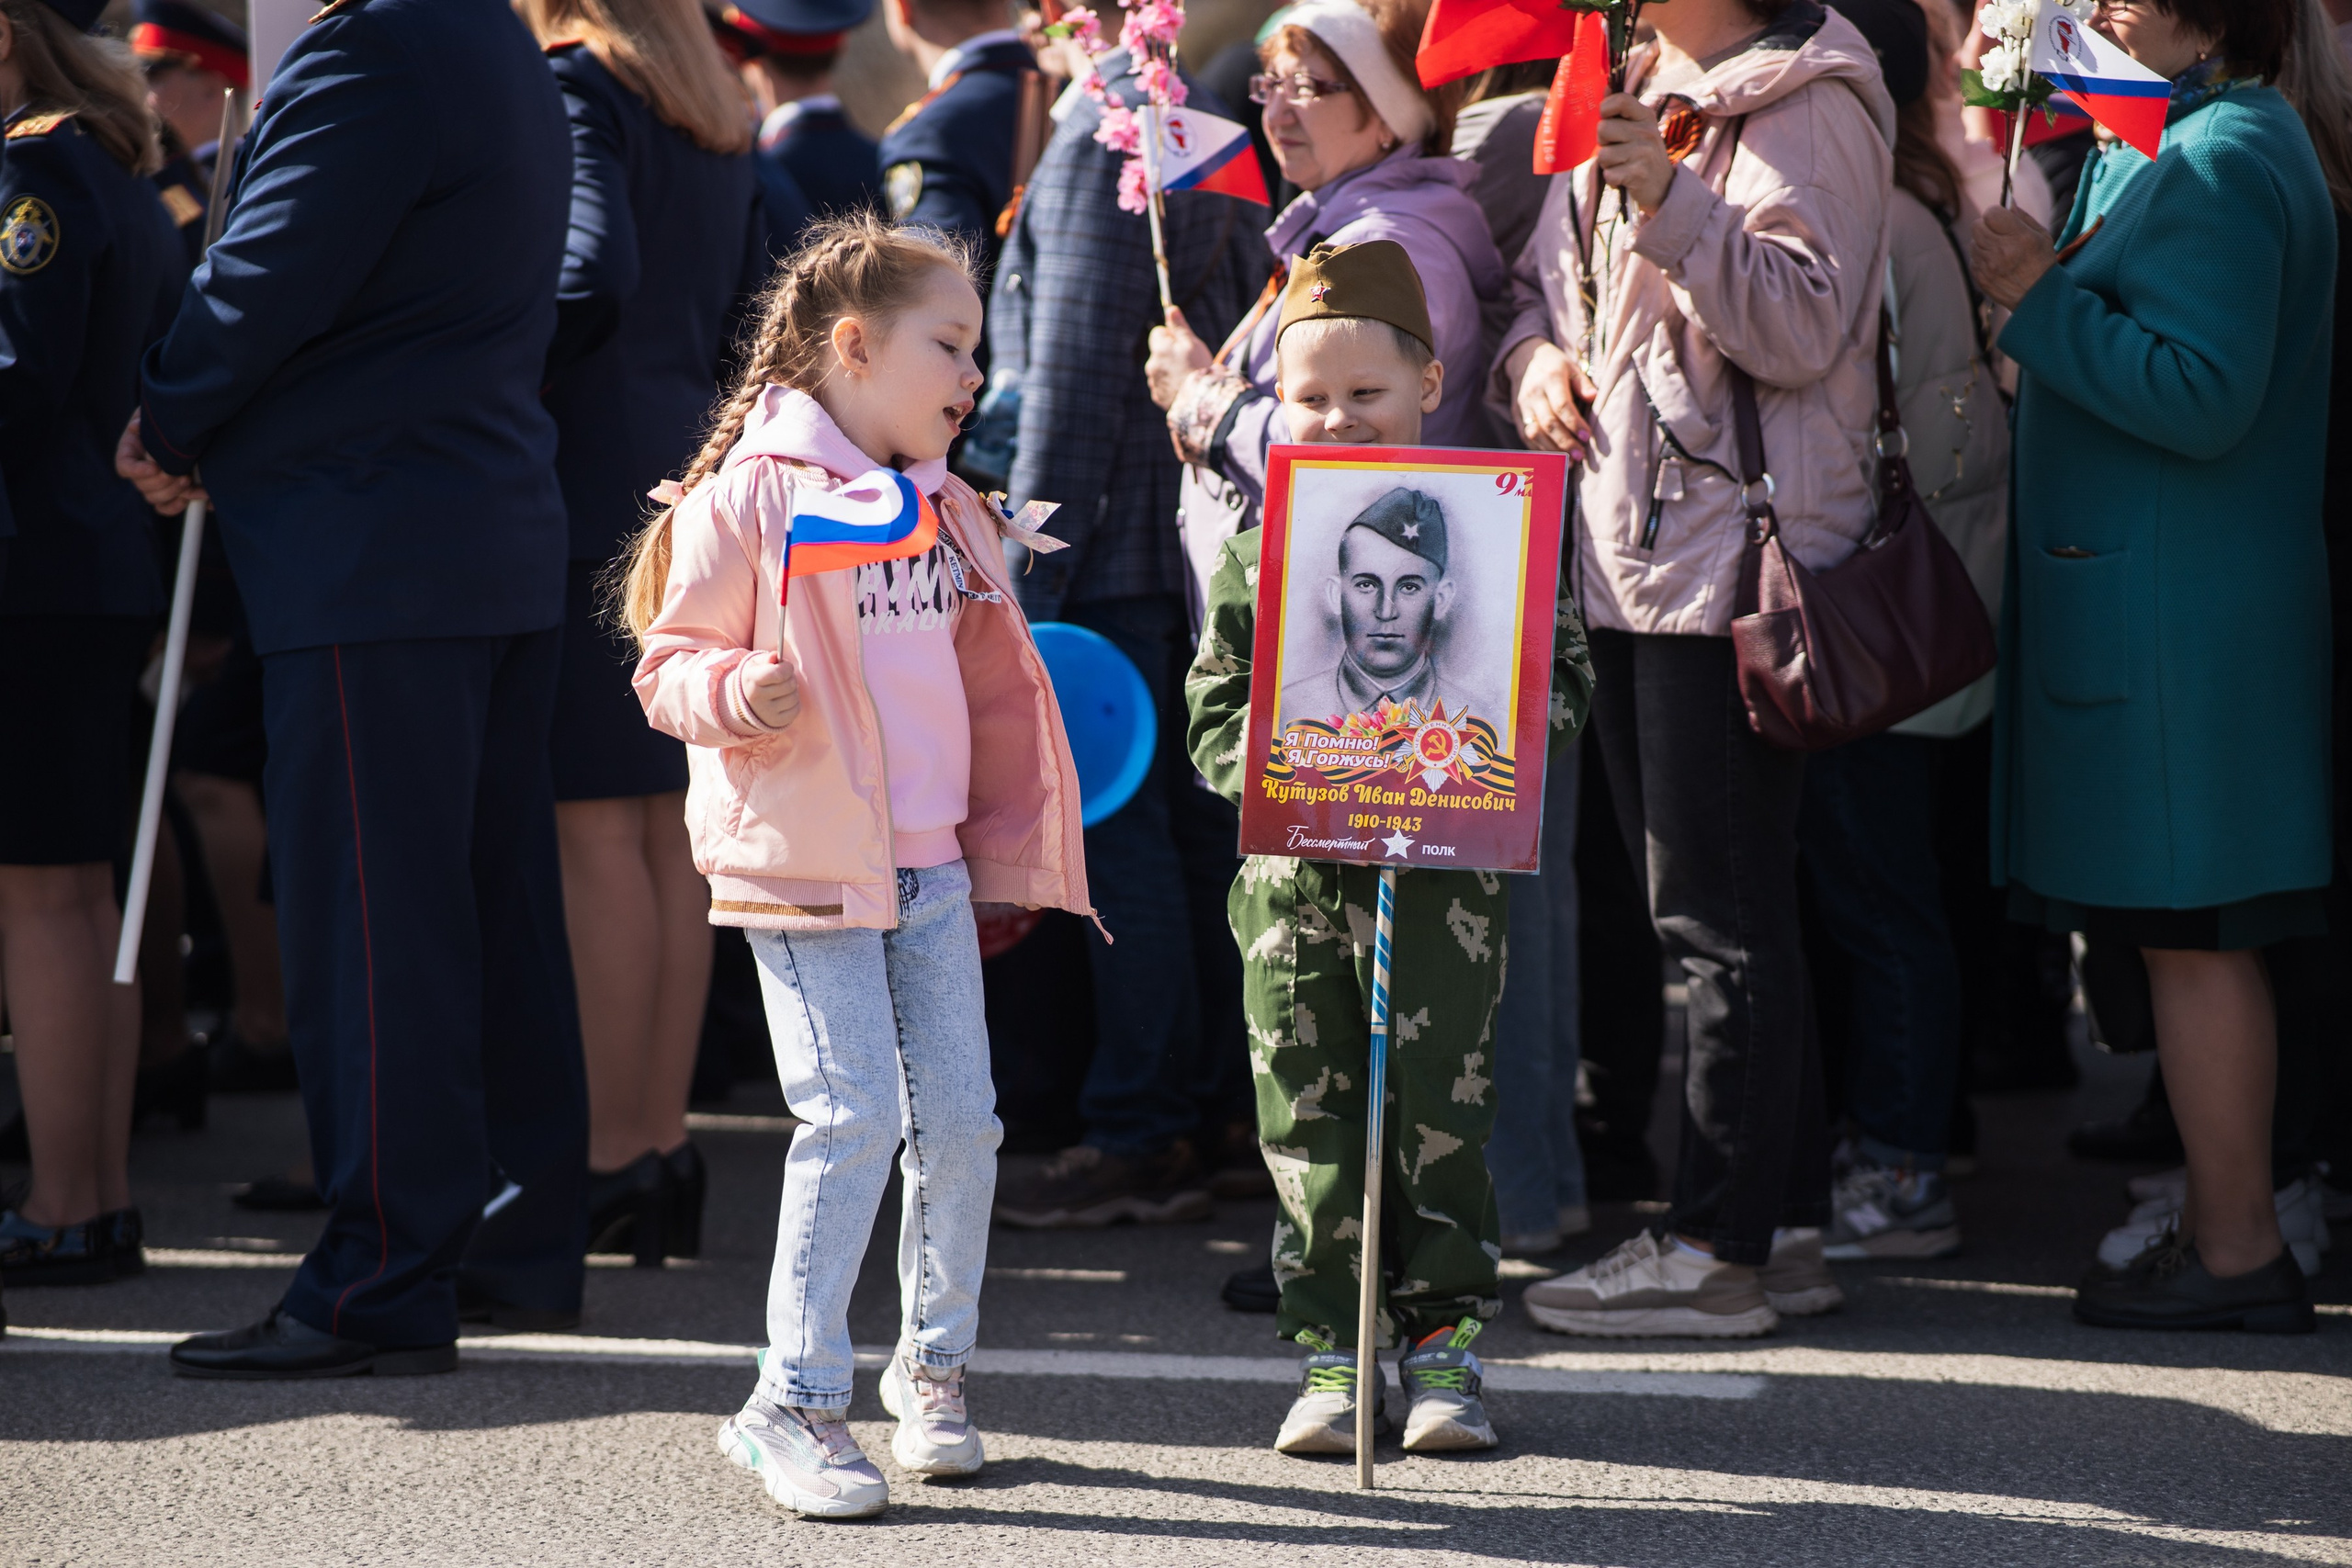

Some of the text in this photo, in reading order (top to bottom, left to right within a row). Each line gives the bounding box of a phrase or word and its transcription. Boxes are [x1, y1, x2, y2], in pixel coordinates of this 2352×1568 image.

[1495, 471, 1519, 497] 9
[948, 556, 965, 589] KETMIN
[1285, 732, 1300, 747] Я
[1287, 749, 1303, 763] Я
[1261, 779, 1516, 812] Кутузов Иван Денисович
[1348, 813, 1422, 832] 1910-1943
[1286, 825, 1376, 852] Бессмертный
